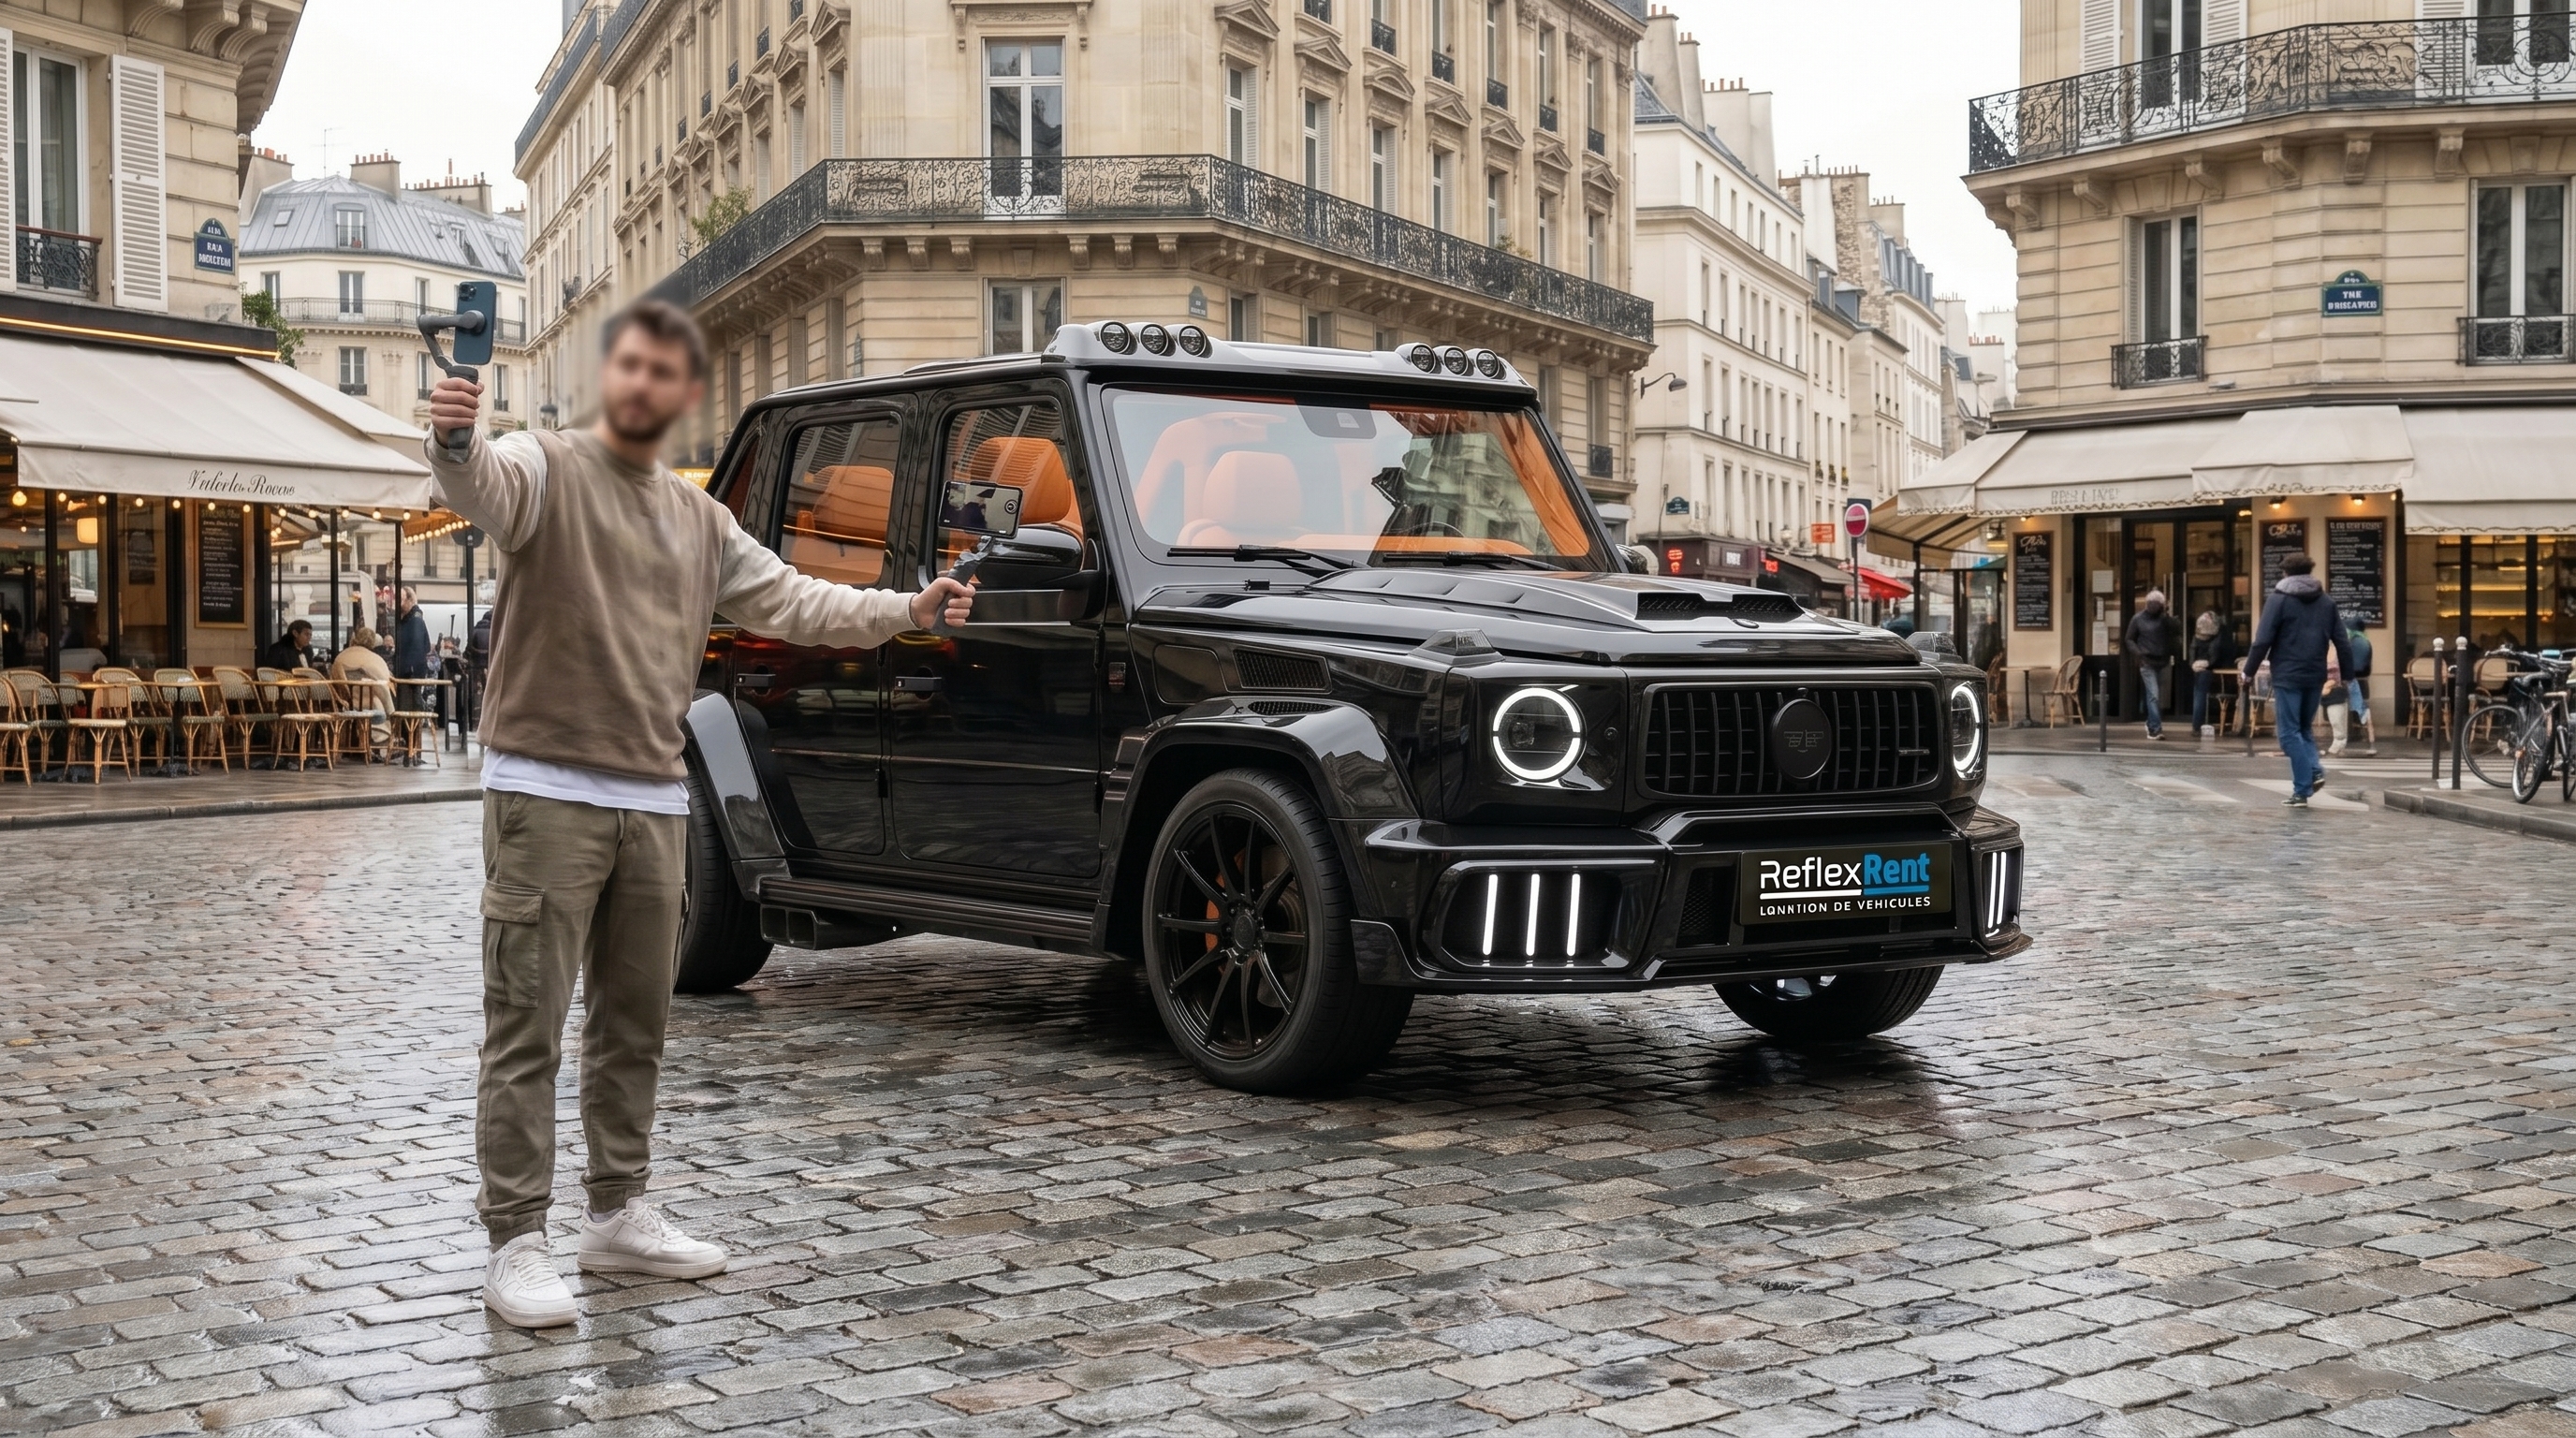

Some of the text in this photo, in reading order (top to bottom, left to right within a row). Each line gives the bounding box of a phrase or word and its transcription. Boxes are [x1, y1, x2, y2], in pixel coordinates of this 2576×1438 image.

[1760, 853, 1930, 888] ReflexRent
[1834, 901, 1852, 912] DE
[1857, 896, 1931, 911] VEHICULES
